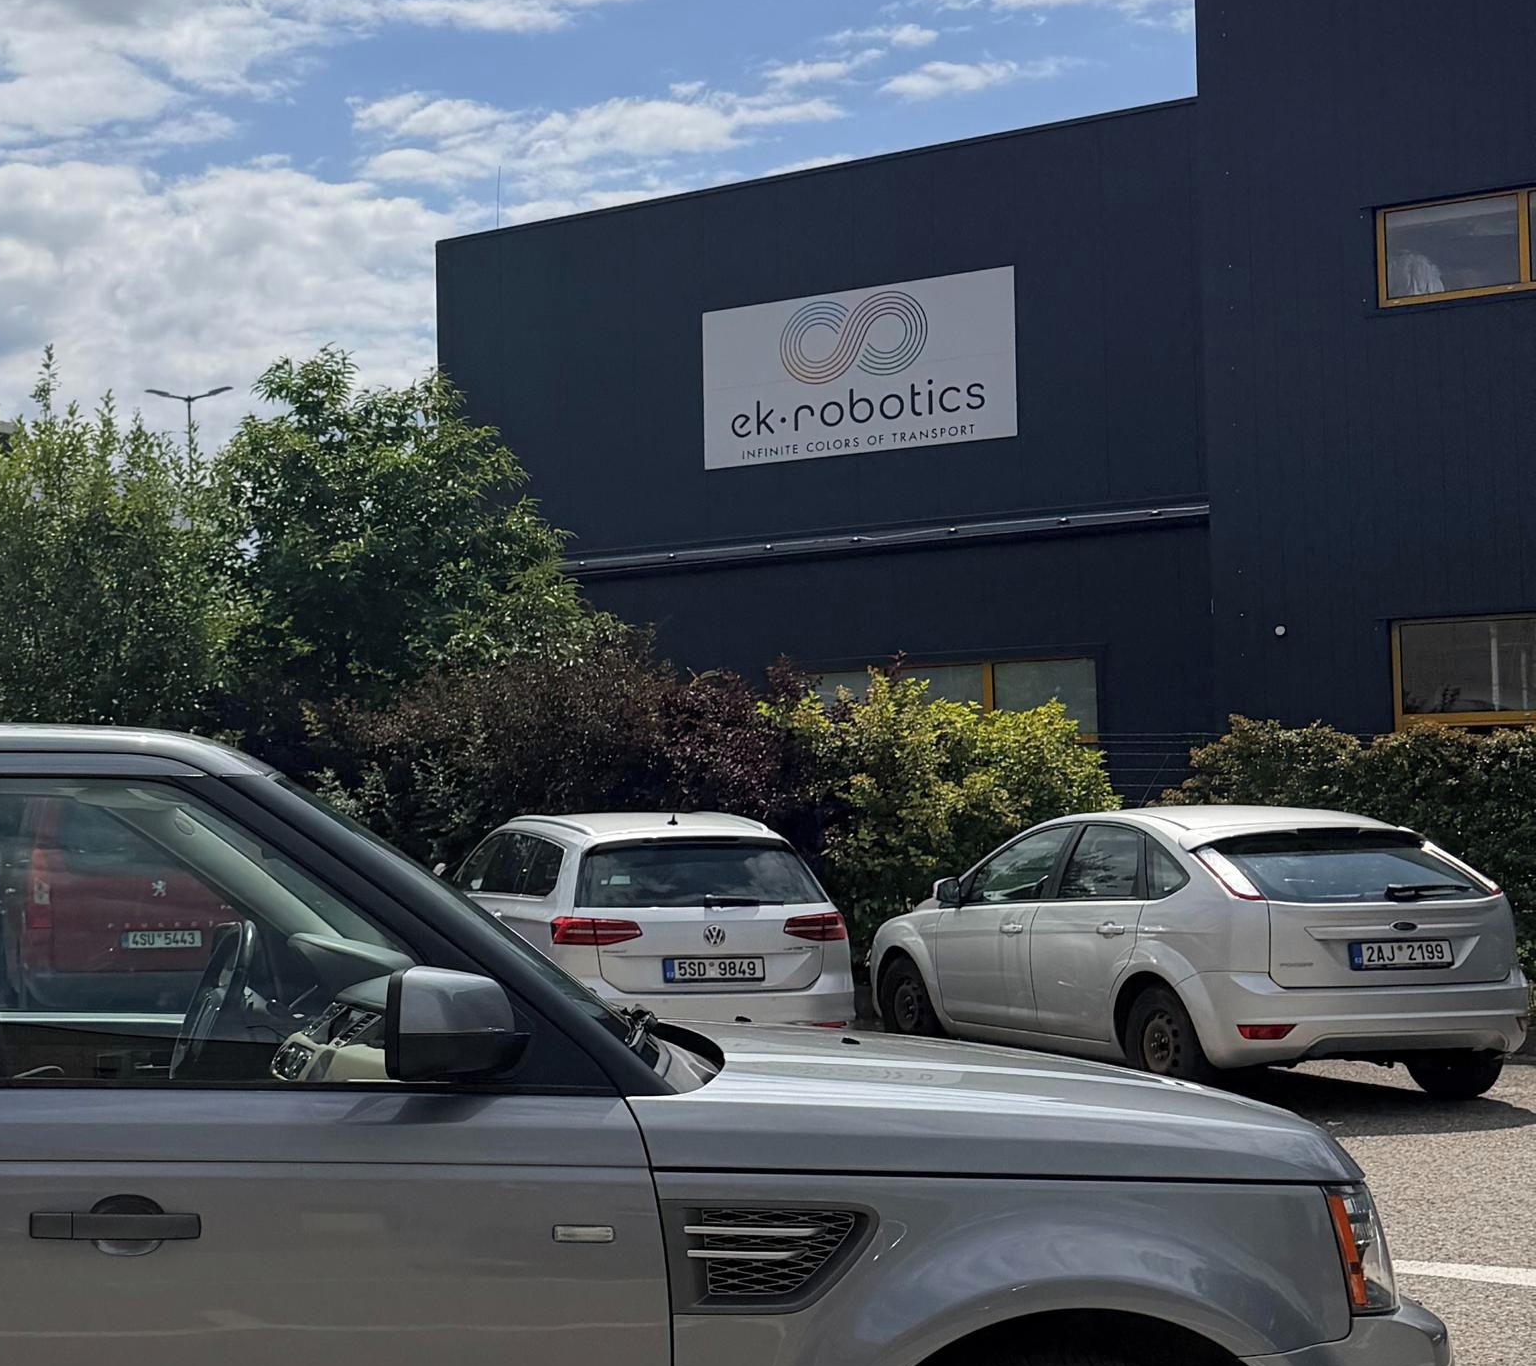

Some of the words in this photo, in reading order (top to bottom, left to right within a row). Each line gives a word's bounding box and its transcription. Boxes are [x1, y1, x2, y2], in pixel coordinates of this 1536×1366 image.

[741, 442, 800, 461] INFINITE
[806, 436, 860, 453] COLORS
[866, 433, 886, 446] OF
[891, 423, 977, 443] TRANSPORT
[131, 933, 156, 946] 4SU
[164, 932, 196, 946] 5443
[1366, 944, 1396, 963] 2AJ
[1406, 943, 1445, 961] 2199
[677, 960, 707, 977] 5SD
[718, 960, 757, 977] 9849
